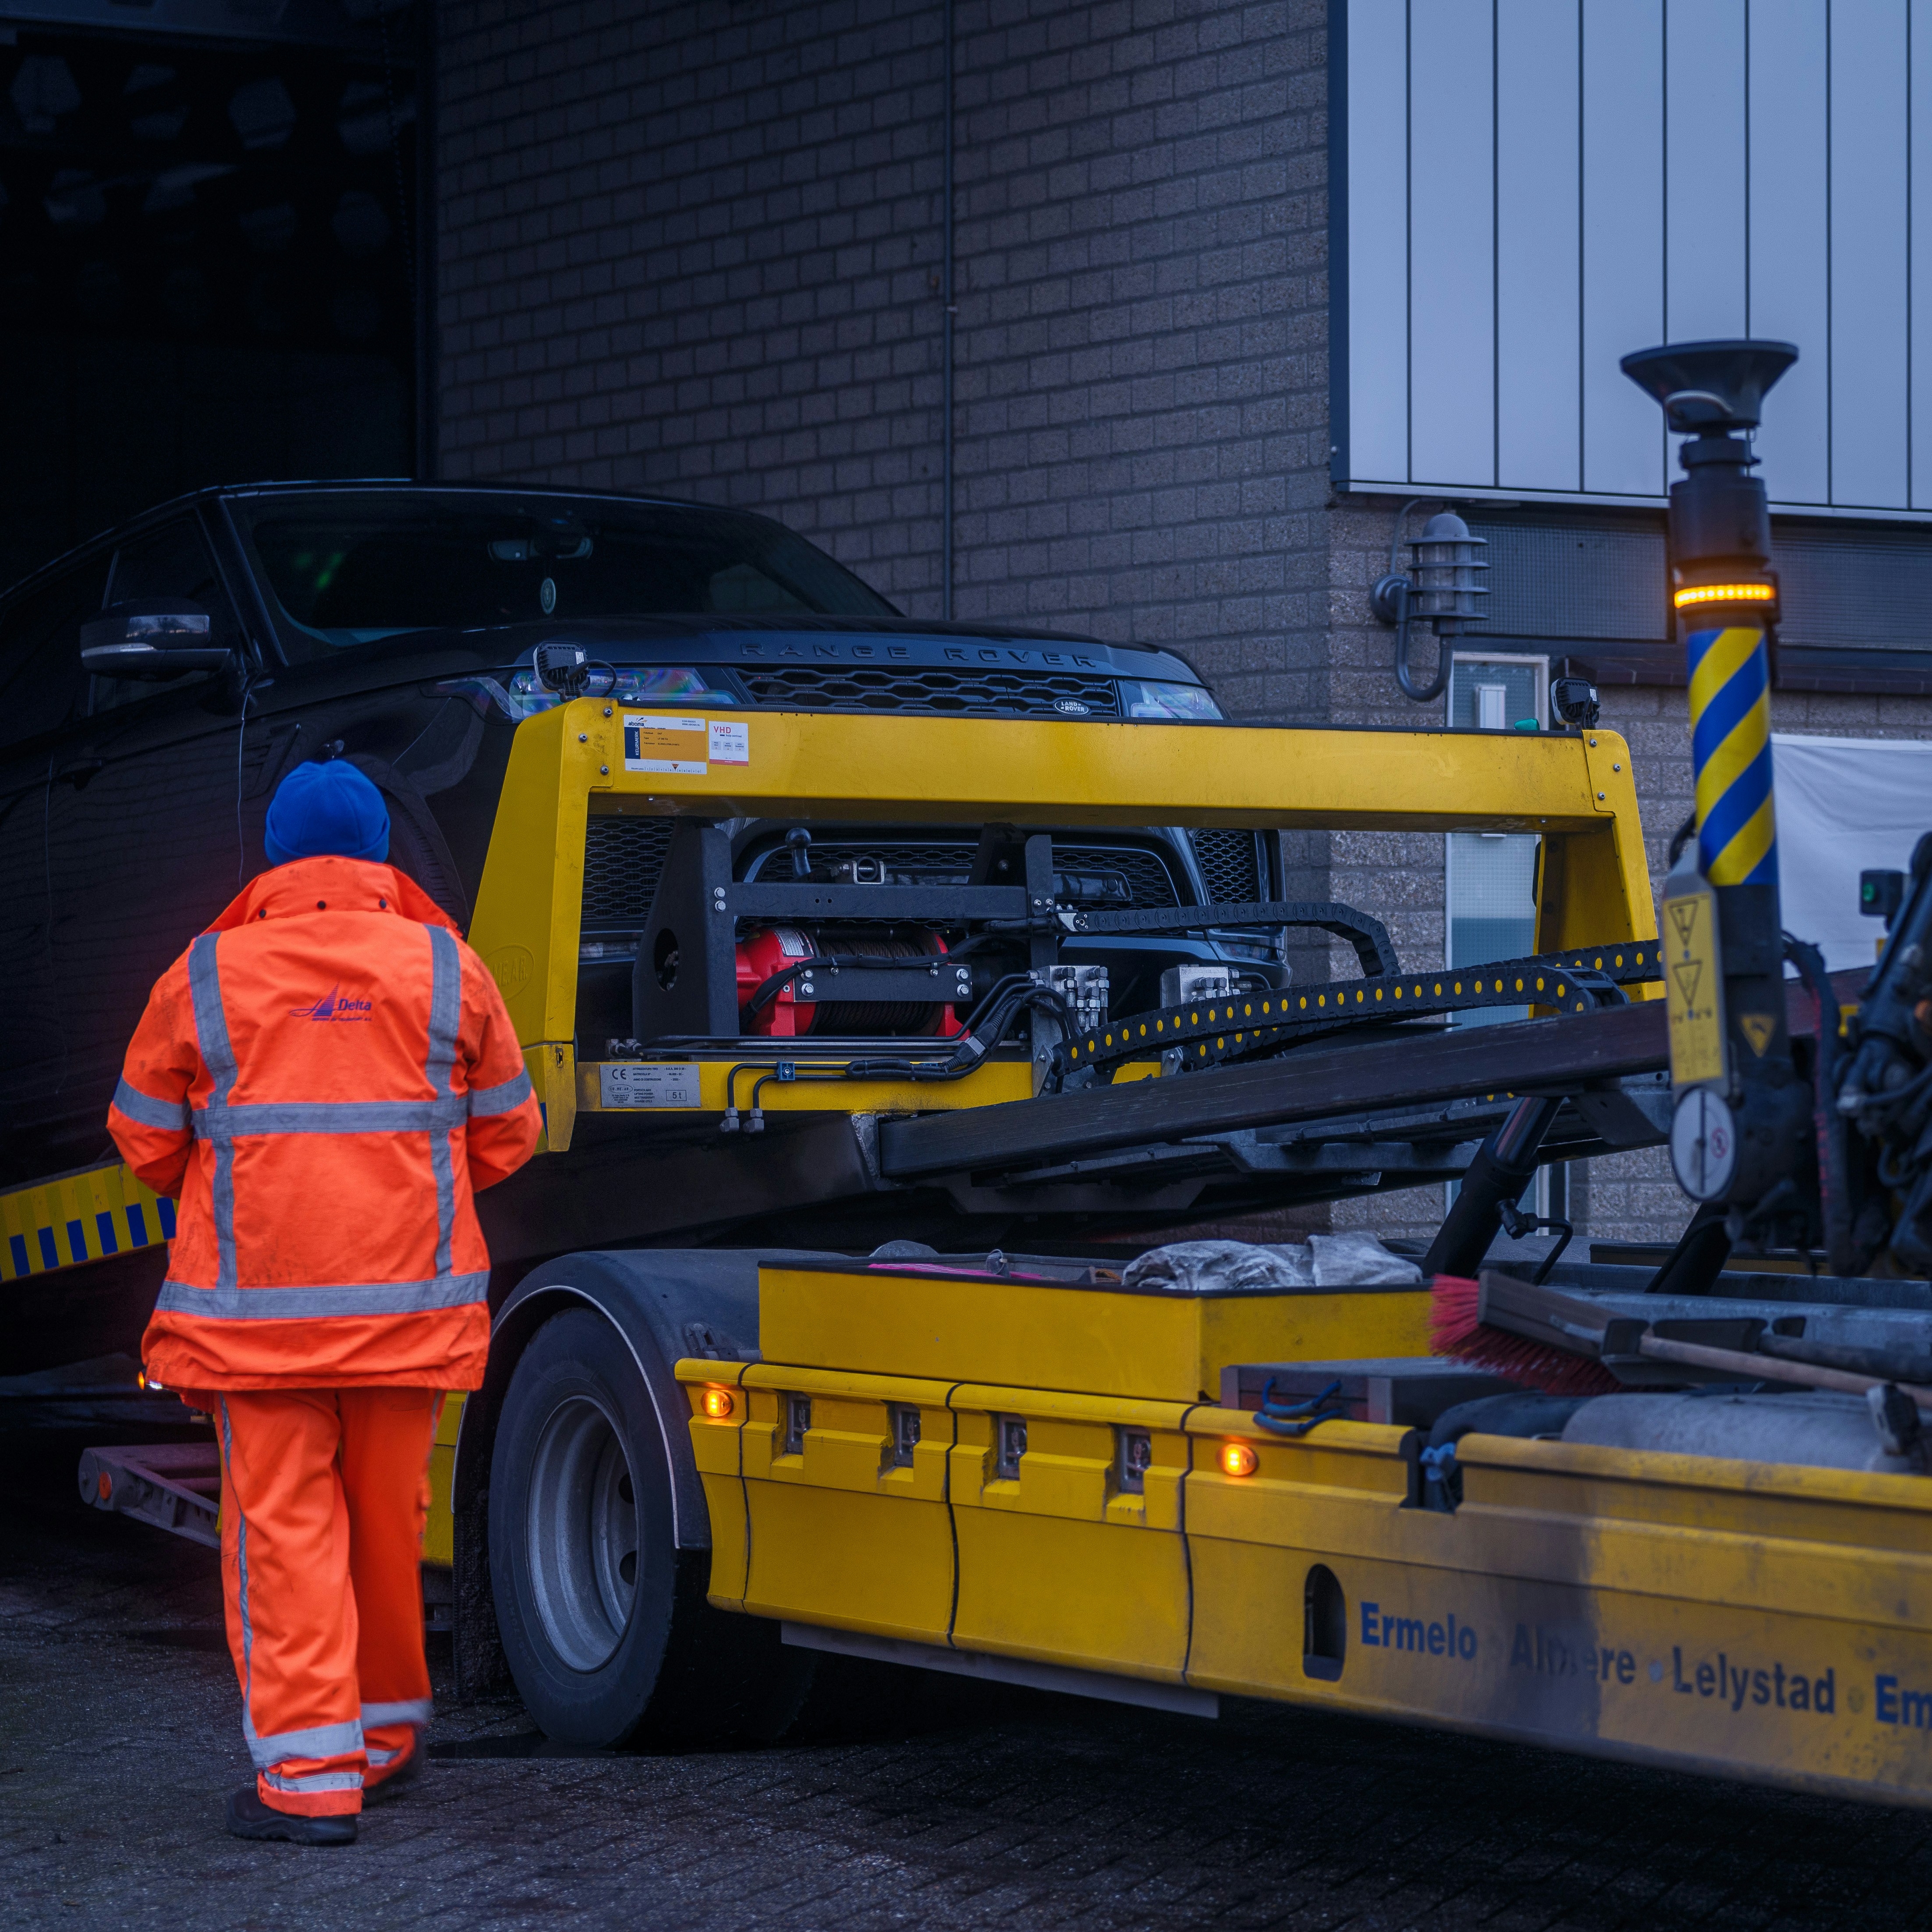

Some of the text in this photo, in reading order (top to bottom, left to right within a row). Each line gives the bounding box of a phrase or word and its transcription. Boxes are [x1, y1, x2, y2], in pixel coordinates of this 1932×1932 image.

[741, 644, 1095, 667] RANGE ROVER
[338, 999, 372, 1010] Delta
[612, 1069, 627, 1080] CE
[1360, 1601, 1478, 1661] Ermelo
[1673, 1645, 1836, 1714] Lelystad
